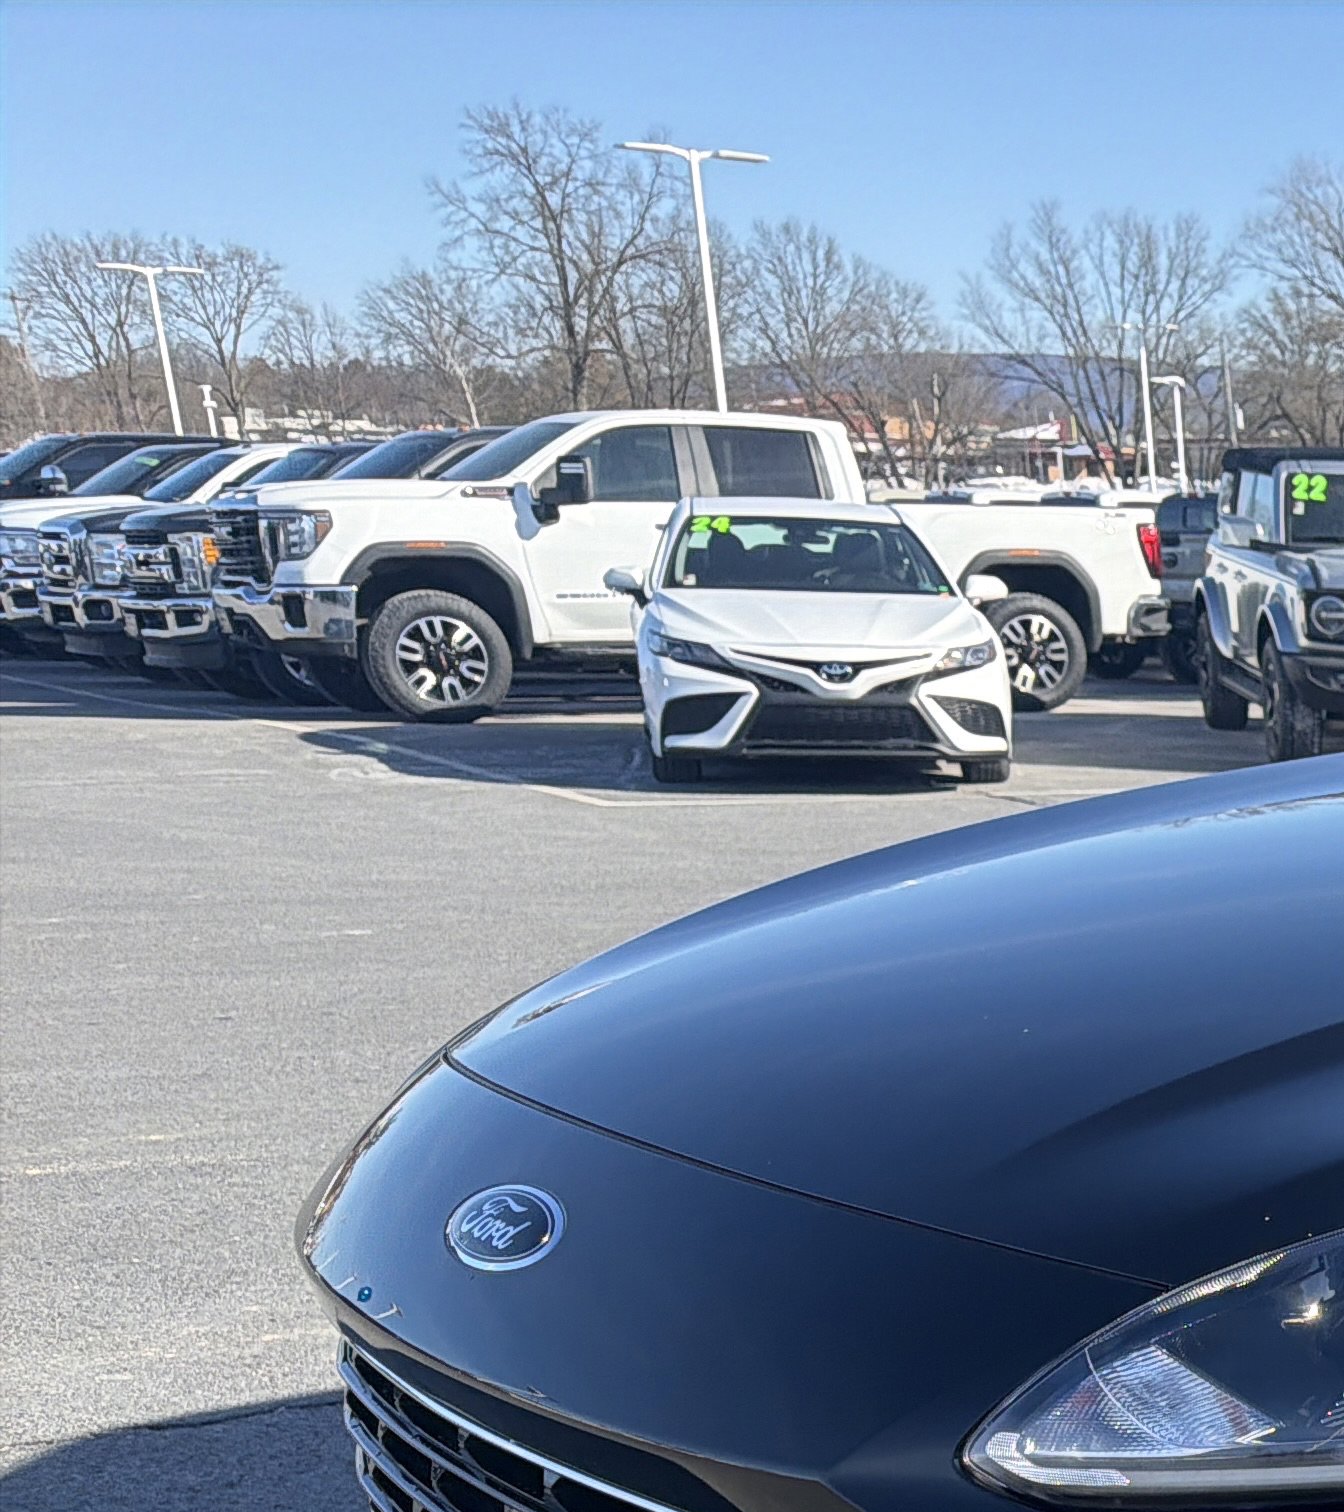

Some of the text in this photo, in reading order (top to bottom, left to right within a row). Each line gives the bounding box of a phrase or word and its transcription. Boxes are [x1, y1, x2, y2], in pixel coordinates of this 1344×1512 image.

[1291, 473, 1328, 502] 22
[690, 516, 730, 533] 24
[460, 1195, 532, 1250] Ford
